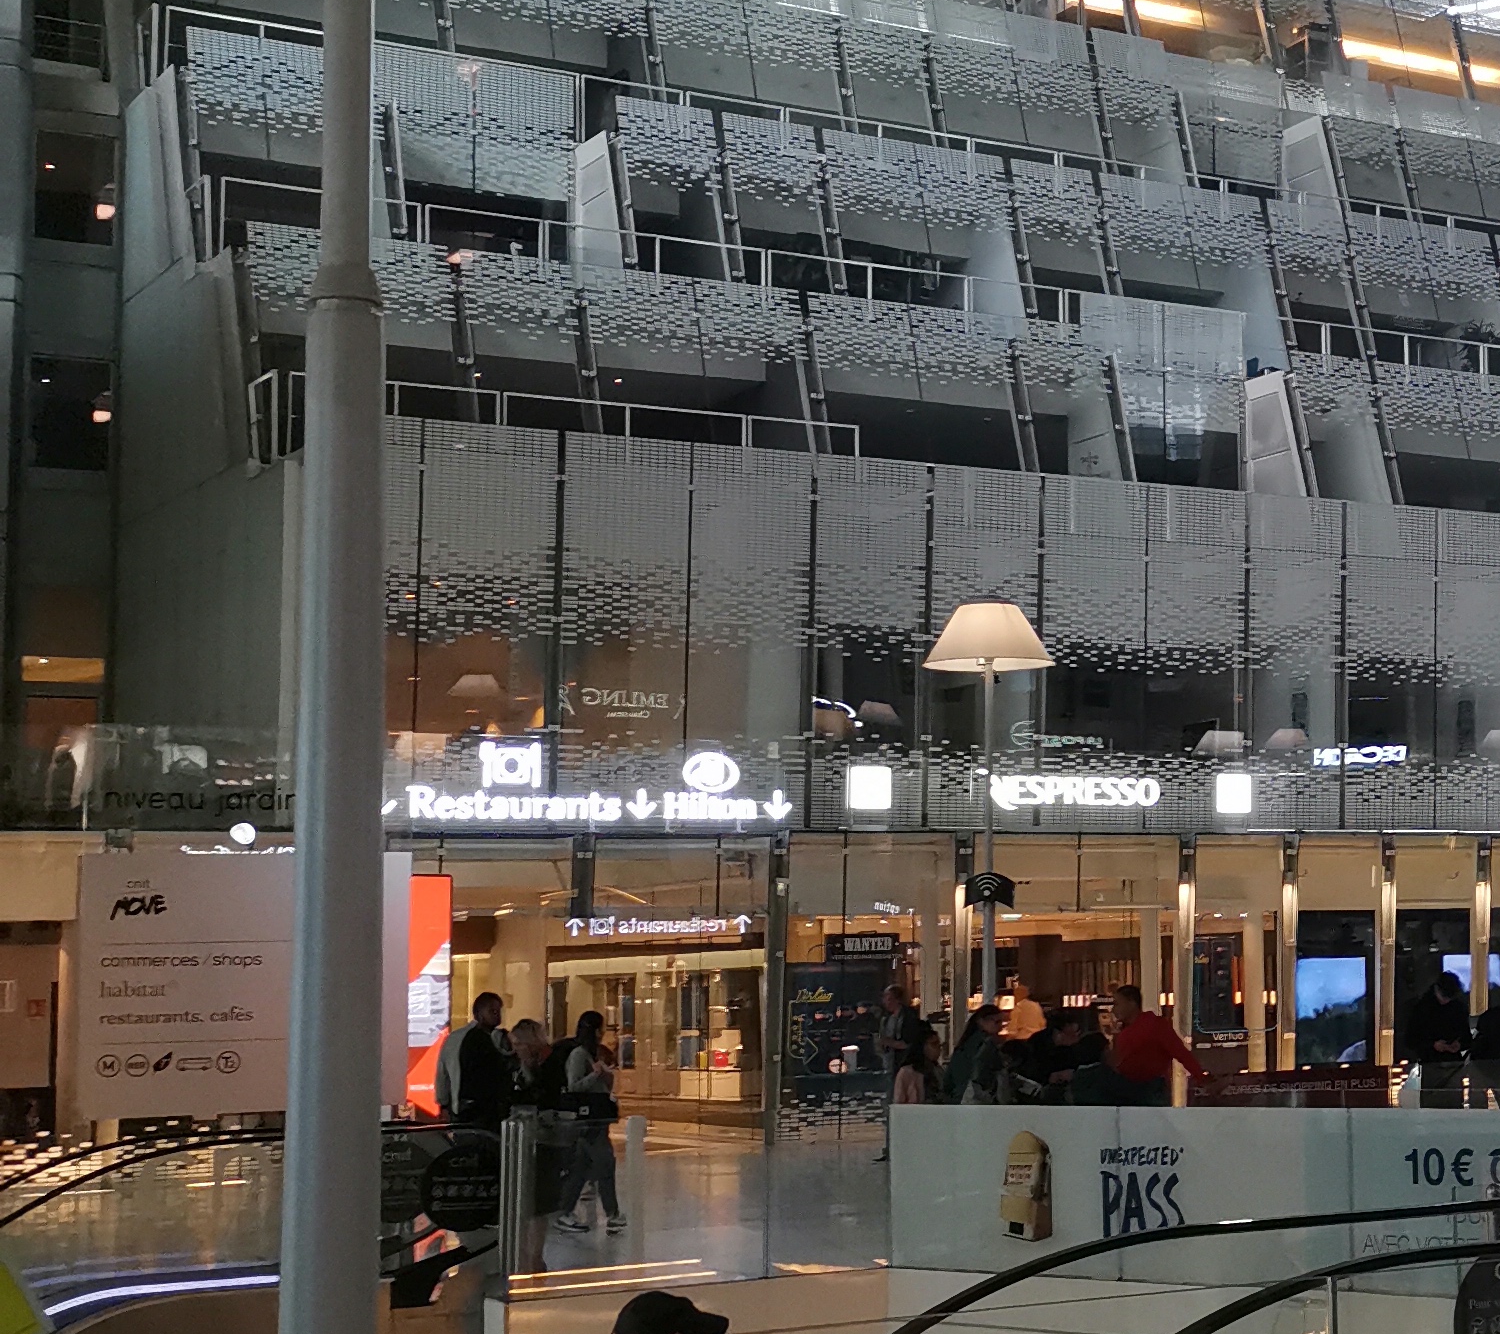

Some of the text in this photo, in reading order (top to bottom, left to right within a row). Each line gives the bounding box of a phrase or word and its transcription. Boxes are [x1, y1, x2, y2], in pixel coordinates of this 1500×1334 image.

[103, 789, 204, 810] niveau
[405, 784, 623, 820] Restaurants
[663, 790, 758, 820] Hilton
[843, 936, 893, 953] WANTED
[99, 954, 200, 968] commerces
[212, 953, 263, 969] shops
[1099, 1170, 1186, 1239] PASS
